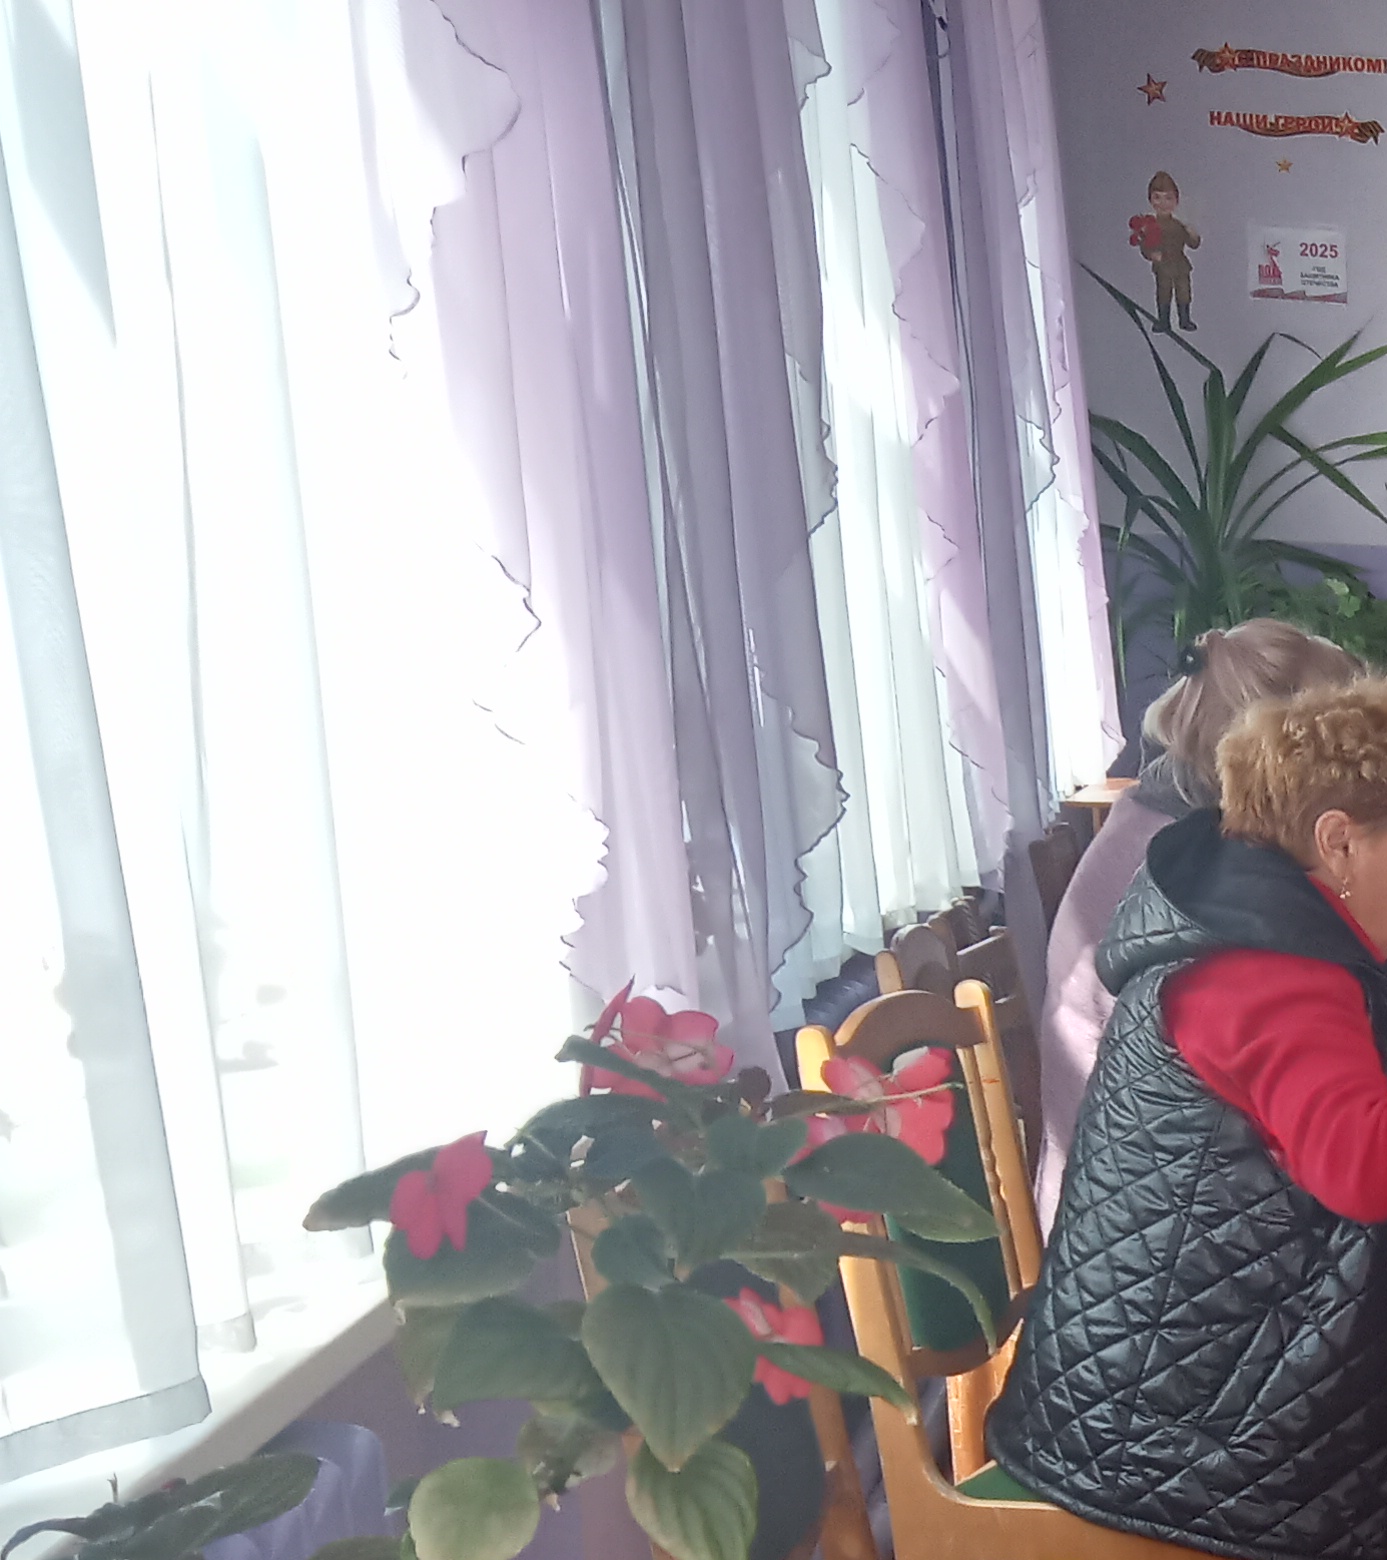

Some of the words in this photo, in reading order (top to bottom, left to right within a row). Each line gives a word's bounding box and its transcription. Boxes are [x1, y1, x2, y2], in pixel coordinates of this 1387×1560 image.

[1254, 52, 1387, 74] ПРАЗДНИКОМ!
[1209, 111, 1269, 129] НАШИ
[1299, 242, 1339, 258] 2025
